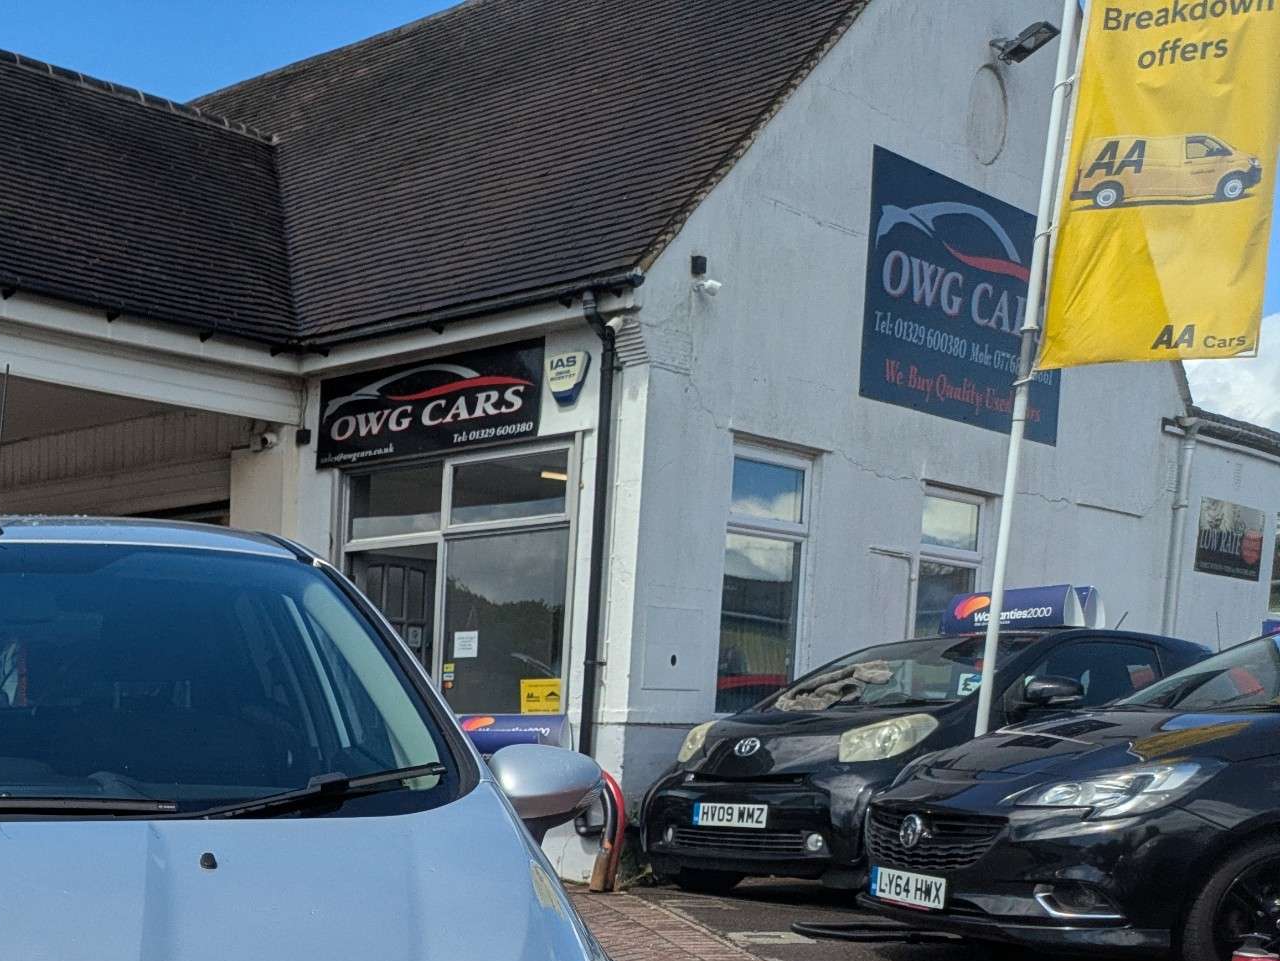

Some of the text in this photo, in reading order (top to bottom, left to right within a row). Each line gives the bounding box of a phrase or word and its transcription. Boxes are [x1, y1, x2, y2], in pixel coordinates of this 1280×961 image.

[1103, 0, 1274, 31] Breakdown
[1137, 37, 1228, 69] offers
[1084, 139, 1147, 178] AA
[882, 249, 963, 317] OWG
[874, 311, 893, 335] Tel:
[894, 318, 925, 346] 01329
[927, 328, 967, 359] 600380
[1151, 324, 1246, 350] AA Cars
[550, 356, 577, 370] IAS
[885, 358, 904, 385] We
[907, 365, 933, 402] Buy
[330, 384, 526, 441] OWG CARS
[453, 421, 534, 444] Tel: 01329 600380
[702, 805, 764, 824] HV09 WMZ
[879, 871, 942, 904] LY64 HWX
